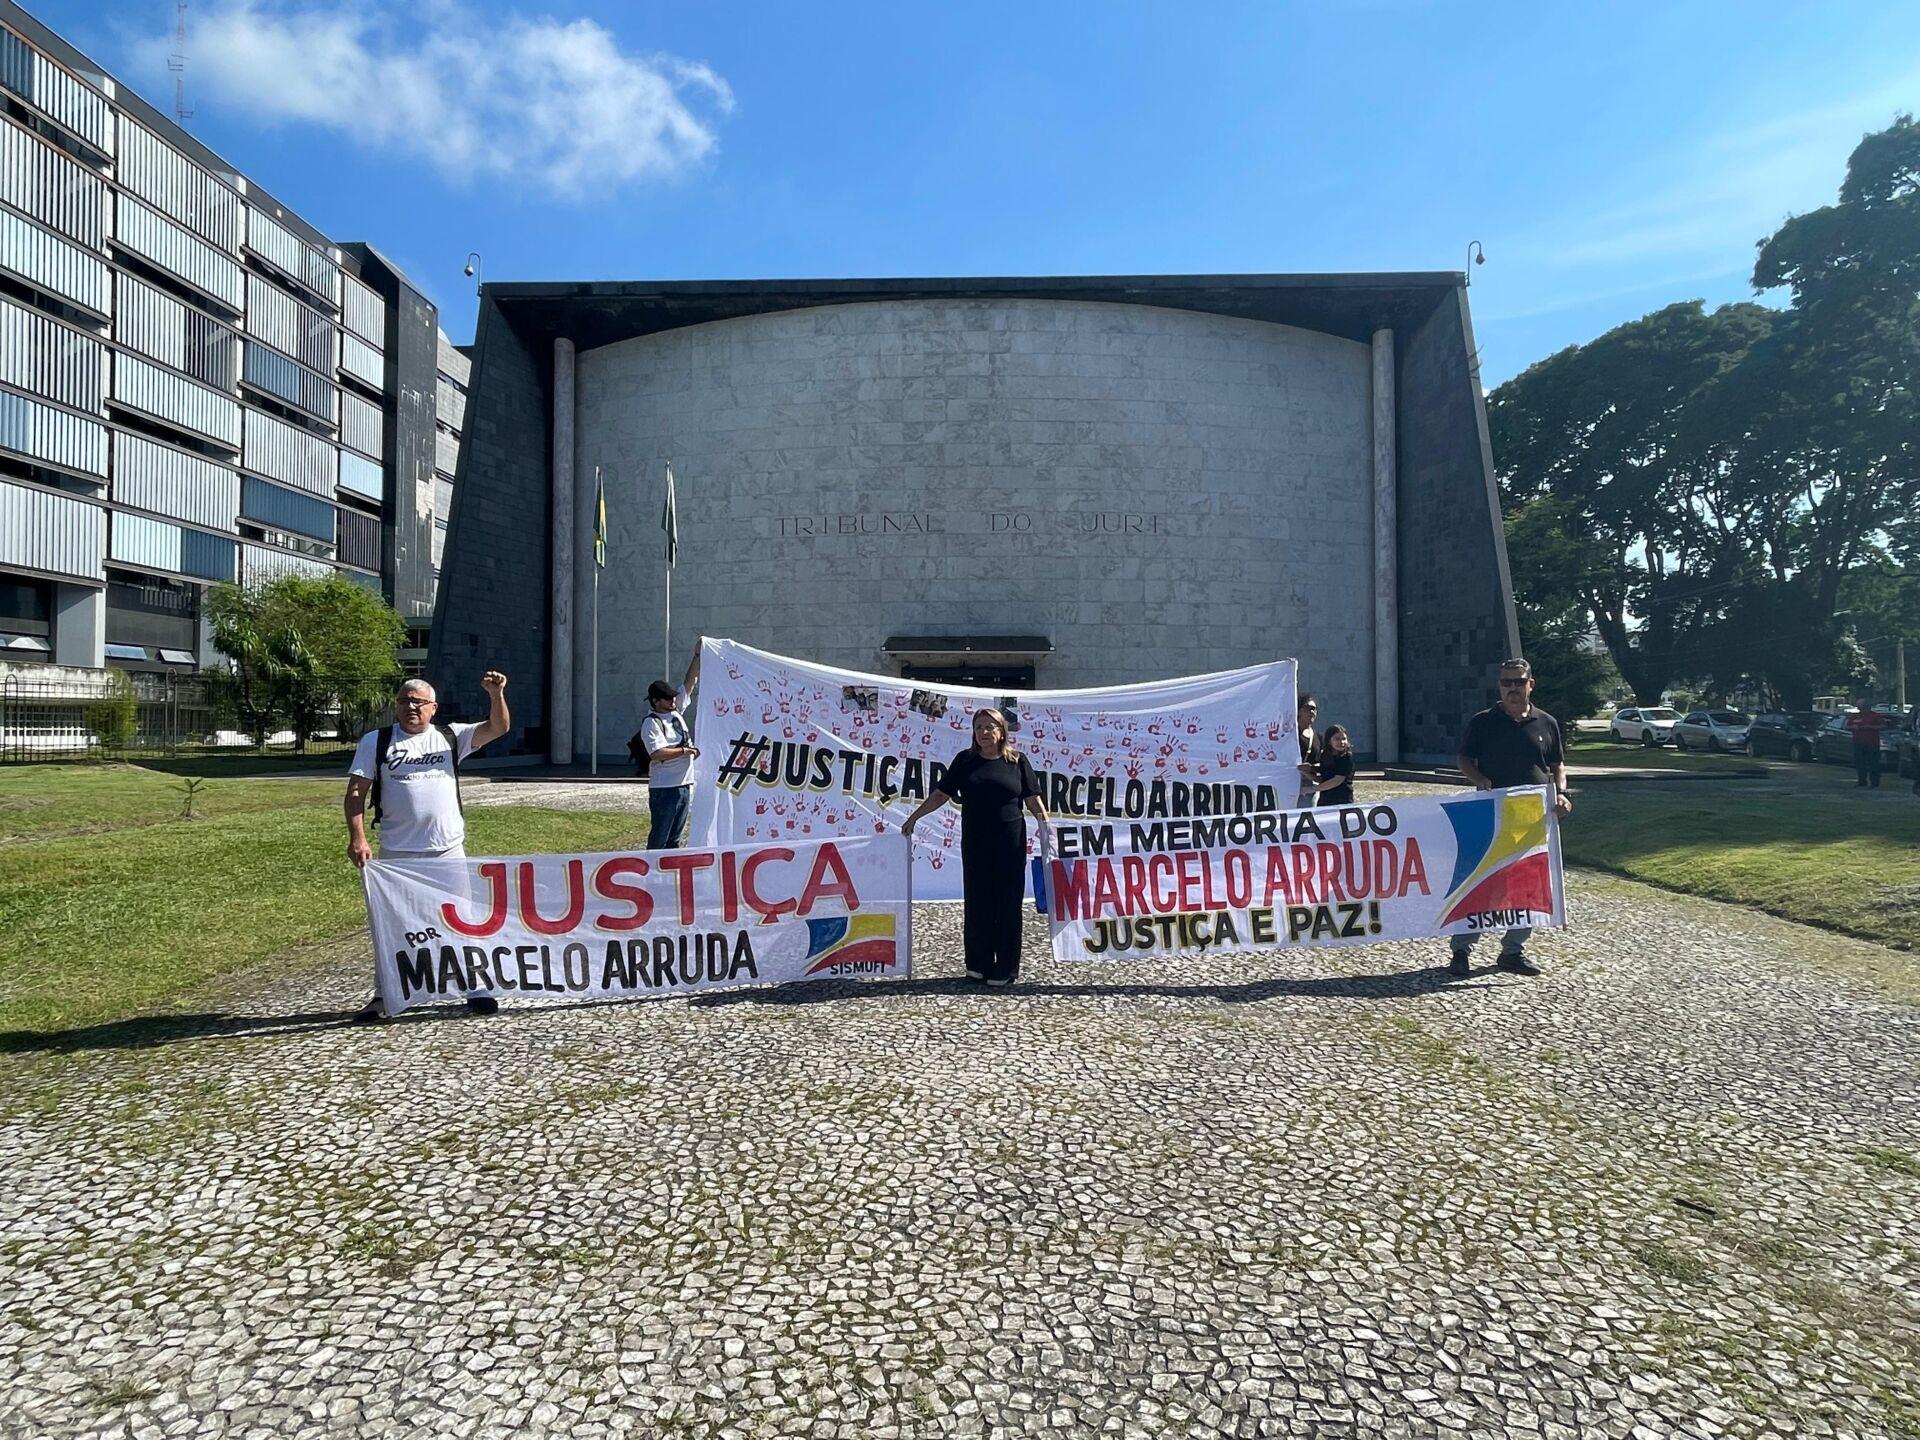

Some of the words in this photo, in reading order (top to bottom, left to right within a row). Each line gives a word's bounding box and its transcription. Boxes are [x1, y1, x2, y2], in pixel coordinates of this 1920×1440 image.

[774, 512, 945, 537] TRIBUNAL
[991, 512, 1032, 533] DO
[388, 749, 446, 771] Justiça
[1057, 823, 1115, 859] EM
[1130, 807, 1326, 854] MEMÓRIA
[1339, 804, 1398, 839] DO
[440, 841, 861, 936] JUSTIÇA
[1051, 847, 1254, 922] MARCELO
[1264, 836, 1432, 909] ARRUDA
[404, 925, 442, 949] POR
[1084, 913, 1239, 953] JUSTIÇA
[1251, 906, 1277, 944] E
[1287, 899, 1384, 944] PAZ!
[1467, 908, 1532, 930] SISMUFI
[395, 941, 591, 1001] MARCELO
[601, 929, 759, 991] ARRUDA
[829, 960, 886, 975] SISMUFI
